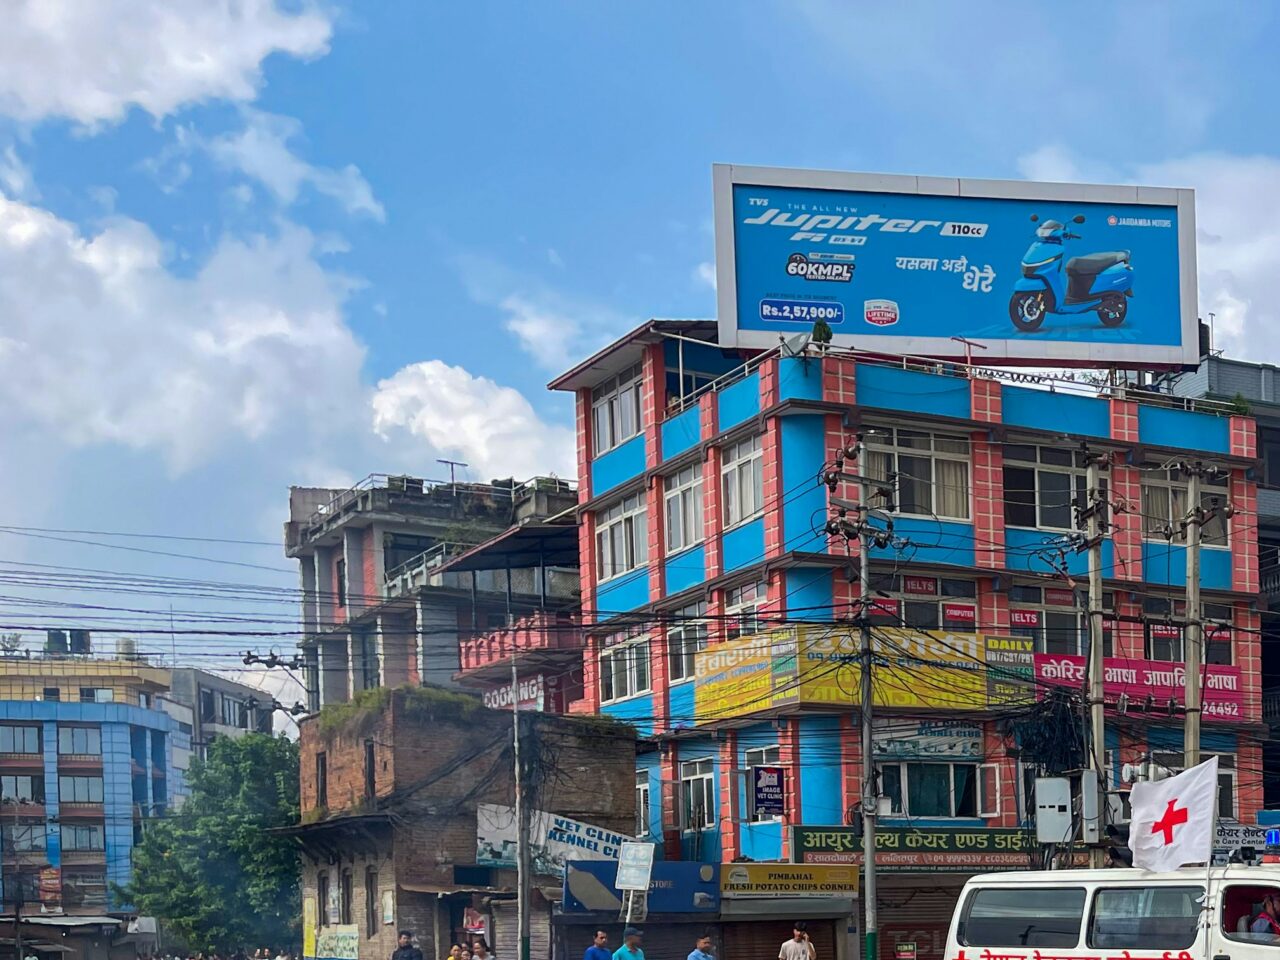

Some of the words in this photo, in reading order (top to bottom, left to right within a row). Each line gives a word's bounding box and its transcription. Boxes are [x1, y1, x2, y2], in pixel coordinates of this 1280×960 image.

[749, 198, 769, 206] TVS
[743, 208, 942, 232] Jupiter
[951, 224, 982, 235] 110cc
[896, 256, 939, 272] यसमा
[942, 255, 967, 273] अझै
[963, 265, 996, 293] धेरै
[907, 580, 934, 591] IELTS
[946, 609, 974, 617] COMPUTER
[1011, 613, 1037, 623] IELTS
[987, 638, 1033, 651] DAILY
[1105, 667, 1136, 684] भाषा
[1206, 673, 1237, 690] भाषा
[554, 818, 581, 833] VET
[549, 830, 599, 853] KENNEL
[906, 829, 949, 849] केयर
[724, 883, 753, 891] FRESH
[755, 883, 790, 891] POTATO
[792, 883, 818, 891] CHIPS
[820, 883, 855, 891] CORNER
